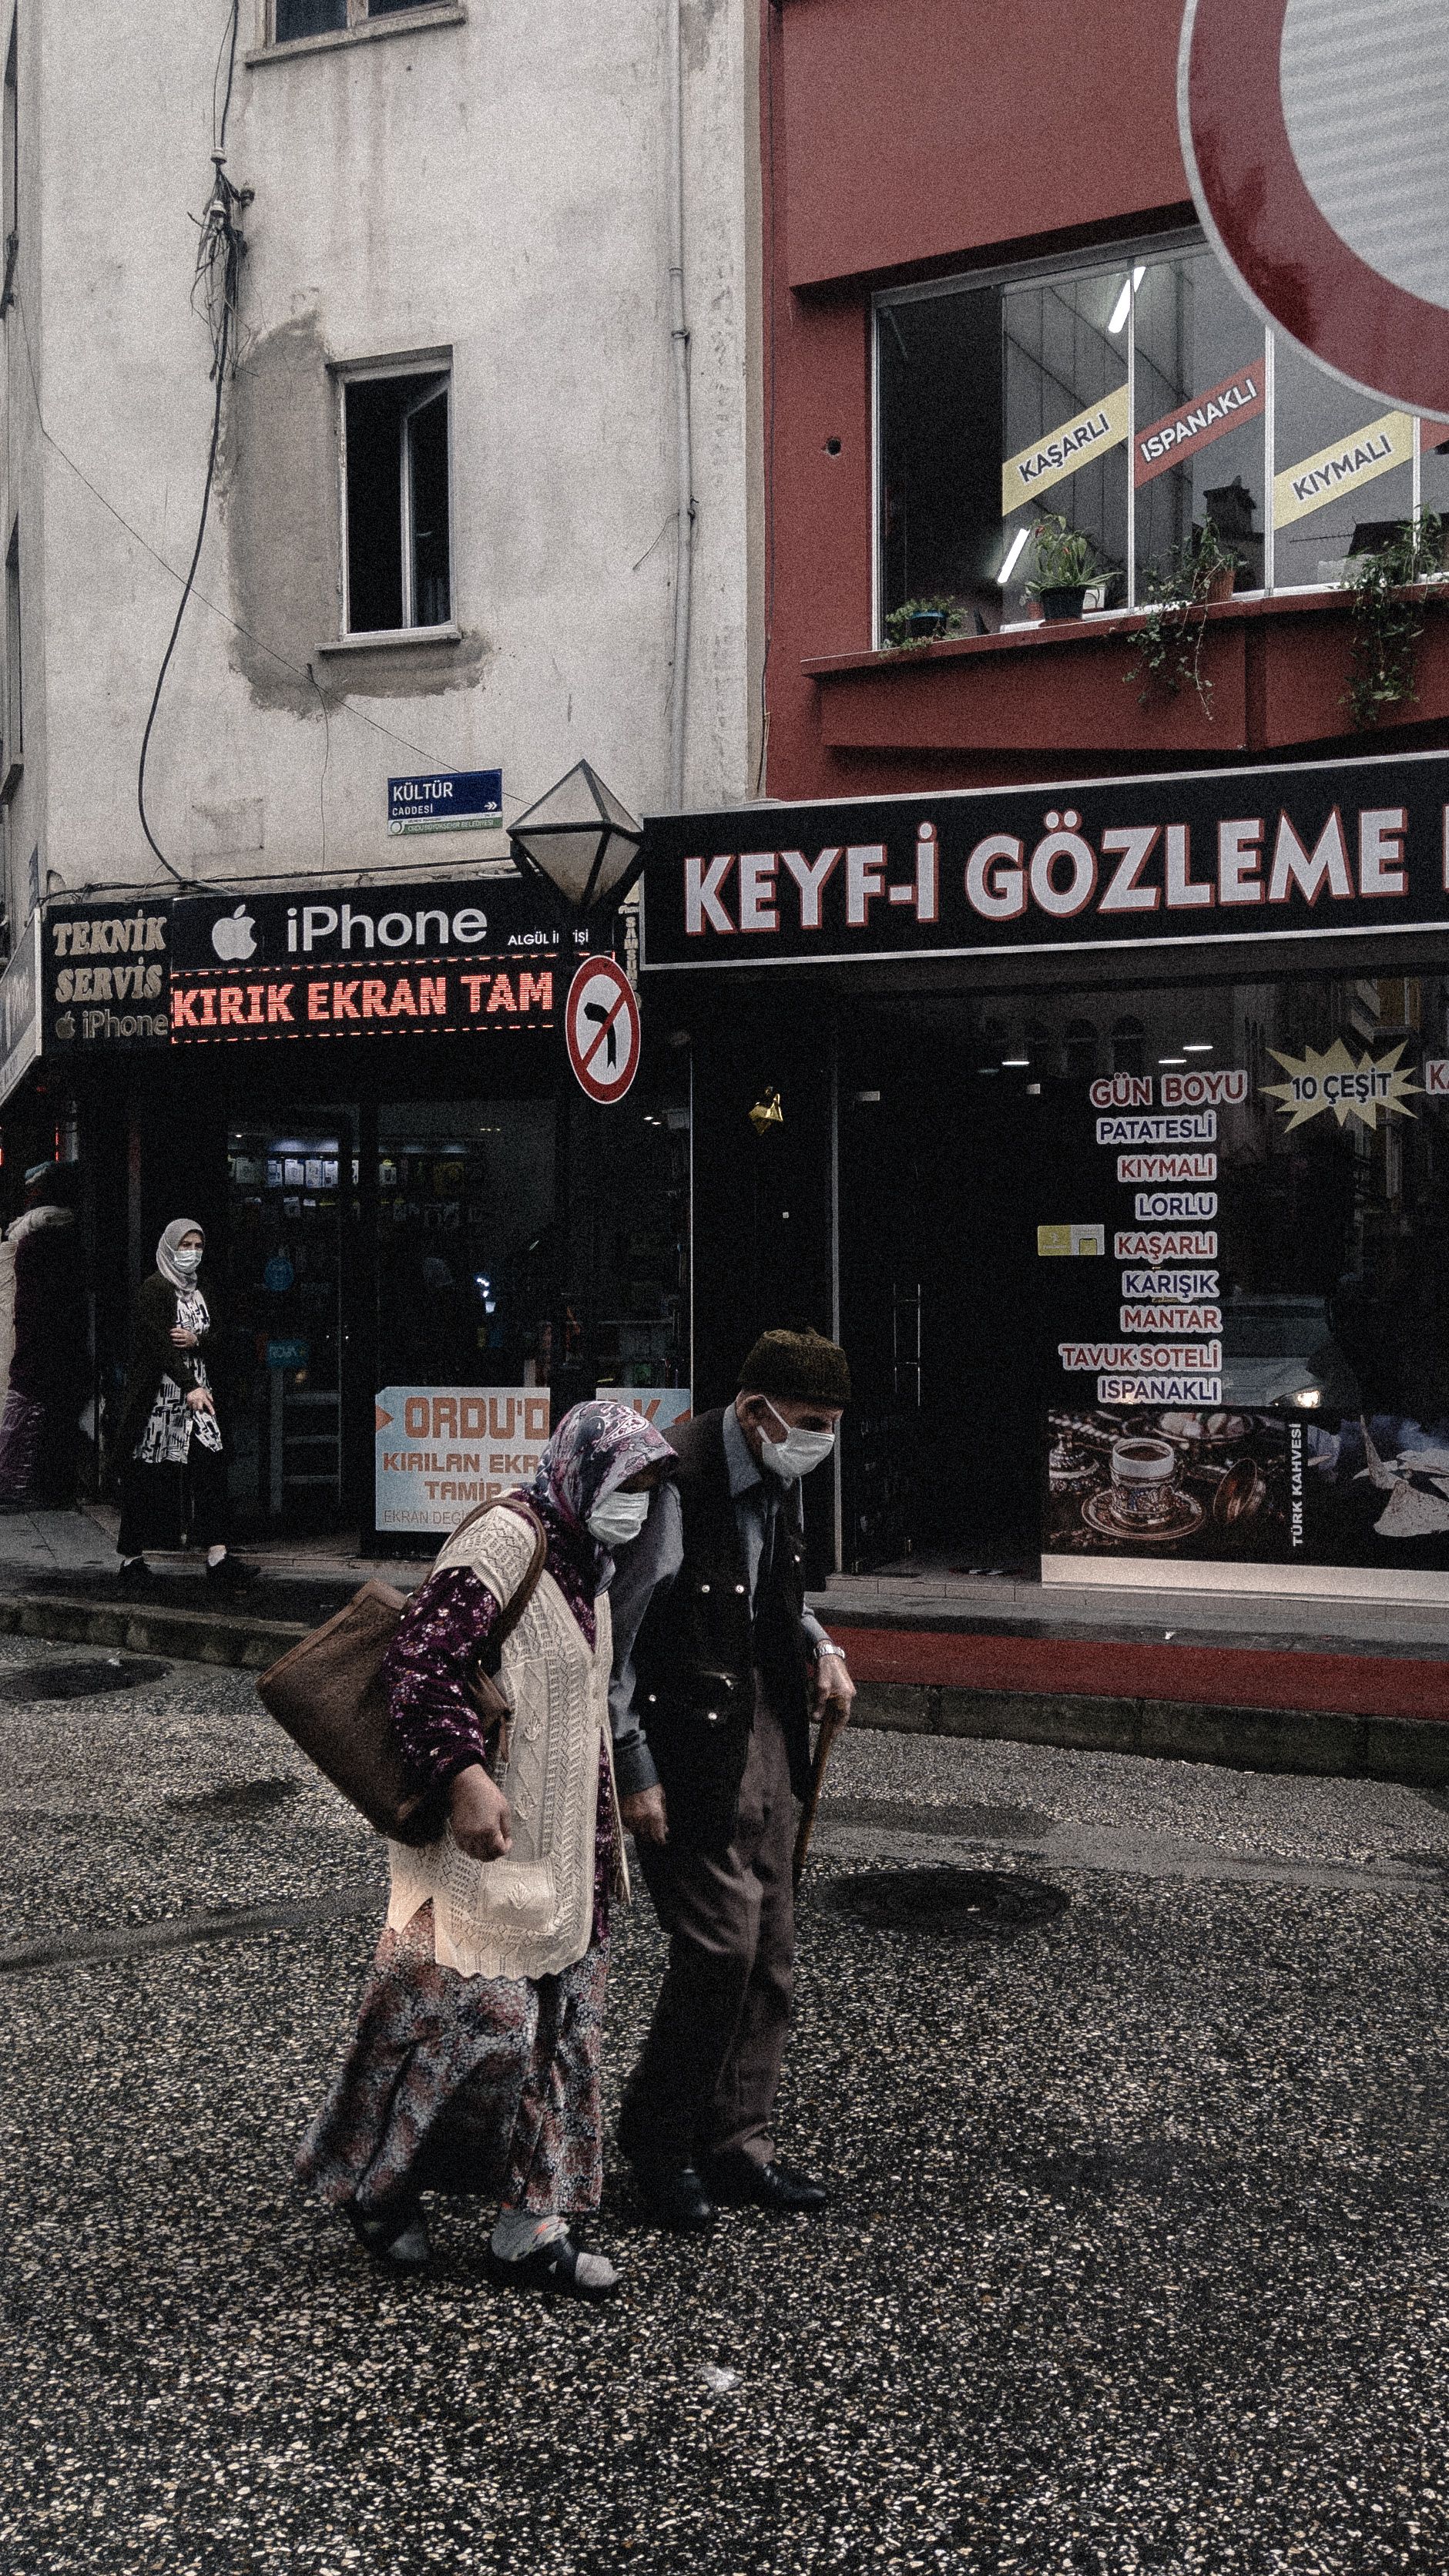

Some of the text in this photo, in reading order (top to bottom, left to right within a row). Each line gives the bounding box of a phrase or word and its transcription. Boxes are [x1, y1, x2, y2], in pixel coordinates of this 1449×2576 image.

[1141, 379, 1258, 461] ISPANAKLI
[1018, 413, 1110, 483] KAŞARLI
[1292, 434, 1393, 501] KIYMALI
[393, 780, 453, 802] KÜLTÜR
[392, 803, 433, 817] CADDESİ
[684, 821, 939, 936] KEYF-İ
[965, 803, 1409, 922] GÖZLEME
[52, 909, 167, 957] TEKNİK
[287, 904, 488, 952] iPhone
[508, 931, 549, 946] ALGÜL
[55, 956, 163, 1002] SERVİS
[173, 983, 294, 1027] KIRIK
[308, 977, 446, 1021] EKRAN
[82, 1008, 169, 1039] iPhone
[1092, 1072, 1244, 1106] GÜN BOYU
[1292, 1067, 1392, 1105] 10 ÇEŞİT
[1429, 1062, 1449, 1091] K
[1099, 1113, 1213, 1140] PATATESLİ
[1121, 1157, 1213, 1179] KIYMALI
[1139, 1196, 1213, 1216] LORLU
[1118, 1235, 1213, 1260] KAŞARLI
[1125, 1274, 1216, 1299] KARIŞIK
[1124, 1309, 1219, 1329] MANTAR
[1062, 1343, 1218, 1368] TAVUK SOTELİ
[1101, 1379, 1218, 1401] ISPANAKLI
[404, 1397, 550, 1441] ORDU'D
[382, 1452, 540, 1474] KIRILAN EKR
[1289, 1423, 1303, 1547] TÜRK KAHVESİ
[384, 1509, 428, 1524] EKRAN
